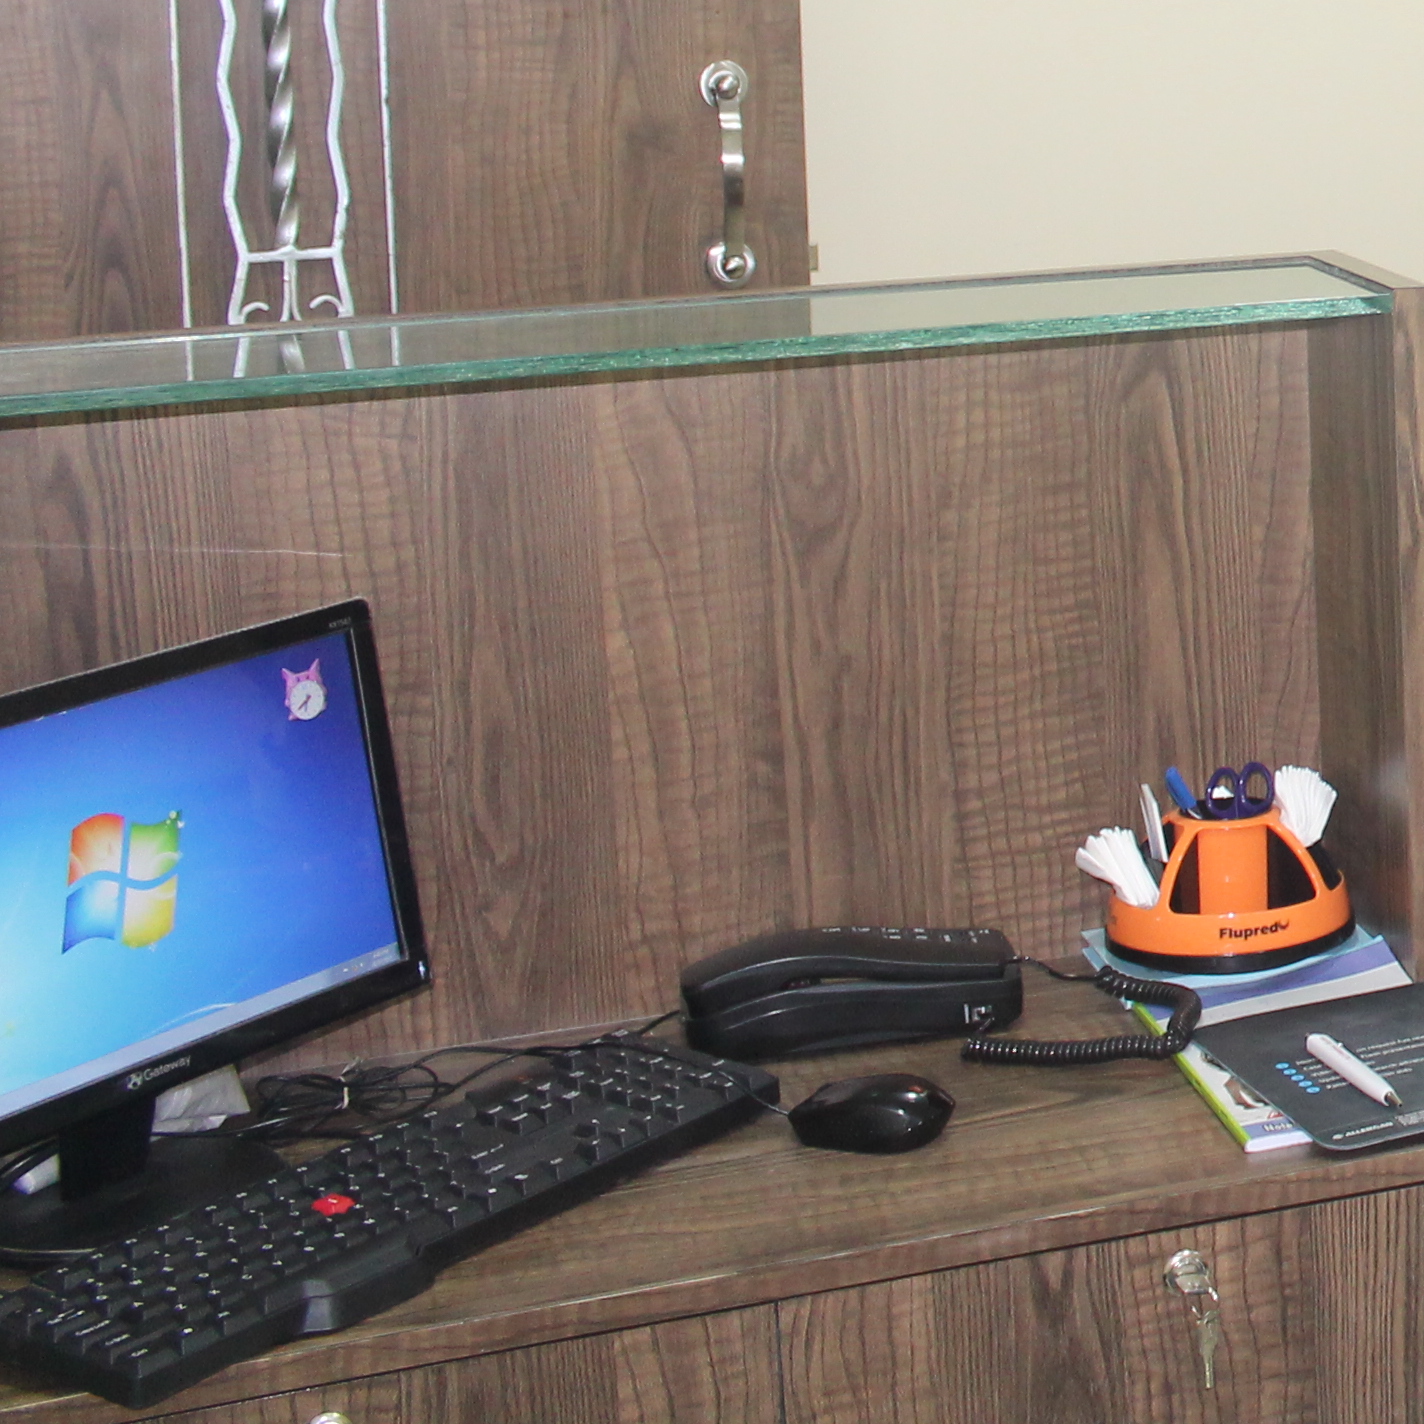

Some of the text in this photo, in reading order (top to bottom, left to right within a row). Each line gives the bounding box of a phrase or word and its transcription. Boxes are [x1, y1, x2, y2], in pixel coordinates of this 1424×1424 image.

[1219, 921, 1279, 940] Flupred
[143, 1055, 191, 1081] Gateway
[1345, 1121, 1394, 1137] ALLERGAN
